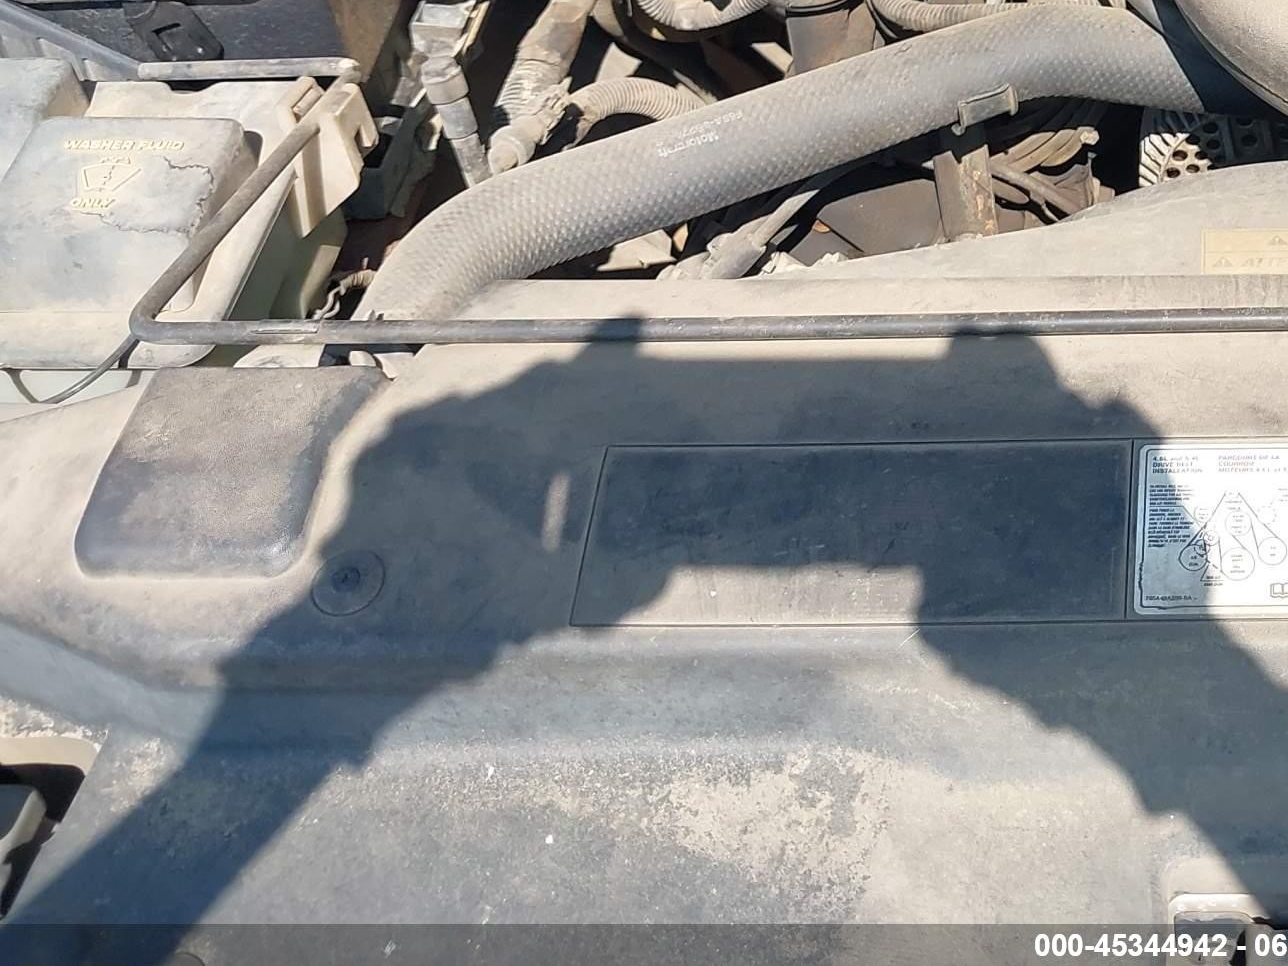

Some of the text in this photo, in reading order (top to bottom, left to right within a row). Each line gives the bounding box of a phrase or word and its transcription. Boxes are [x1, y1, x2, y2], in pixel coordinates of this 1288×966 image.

[63, 138, 187, 151] WASHER FLUID
[69, 197, 117, 209] ONLY
